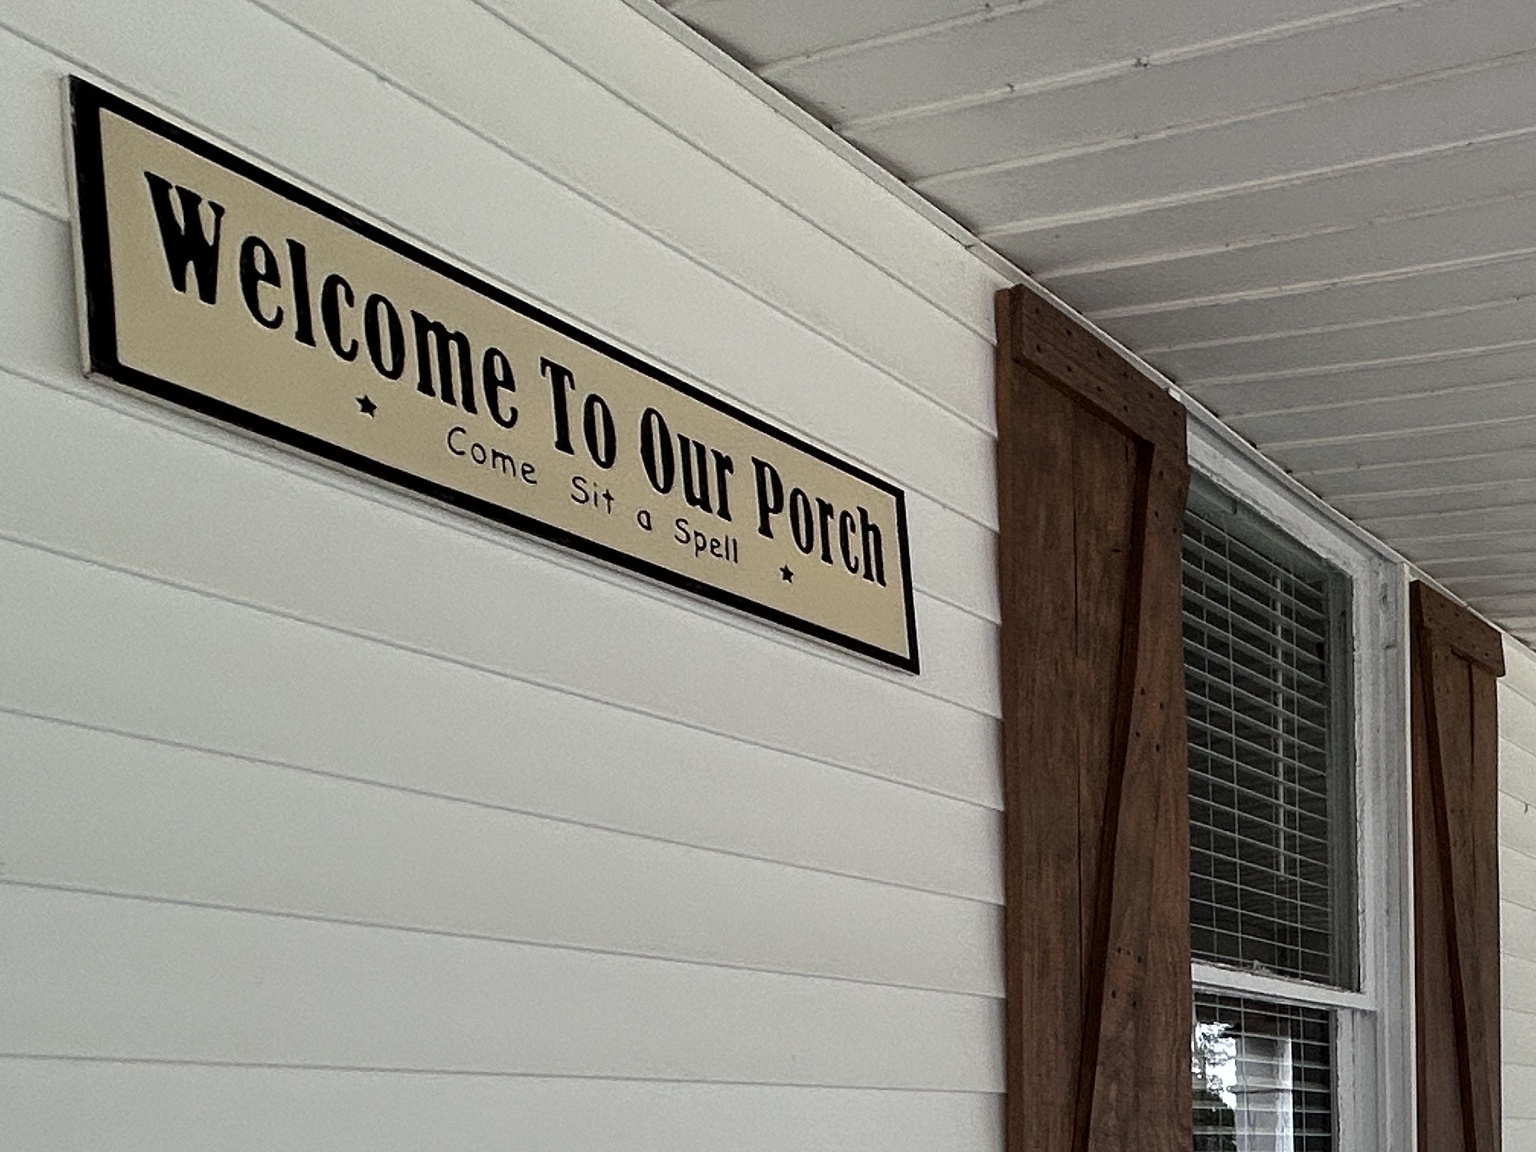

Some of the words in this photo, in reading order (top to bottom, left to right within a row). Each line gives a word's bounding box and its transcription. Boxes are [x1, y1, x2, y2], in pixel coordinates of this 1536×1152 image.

[143, 170, 520, 431] Welcome
[539, 356, 618, 470] To
[640, 407, 736, 524] Our
[751, 456, 888, 588] Porch
[446, 425, 539, 486] Come
[570, 475, 616, 516] Sit
[636, 509, 654, 533] a
[673, 518, 740, 565] Spell
